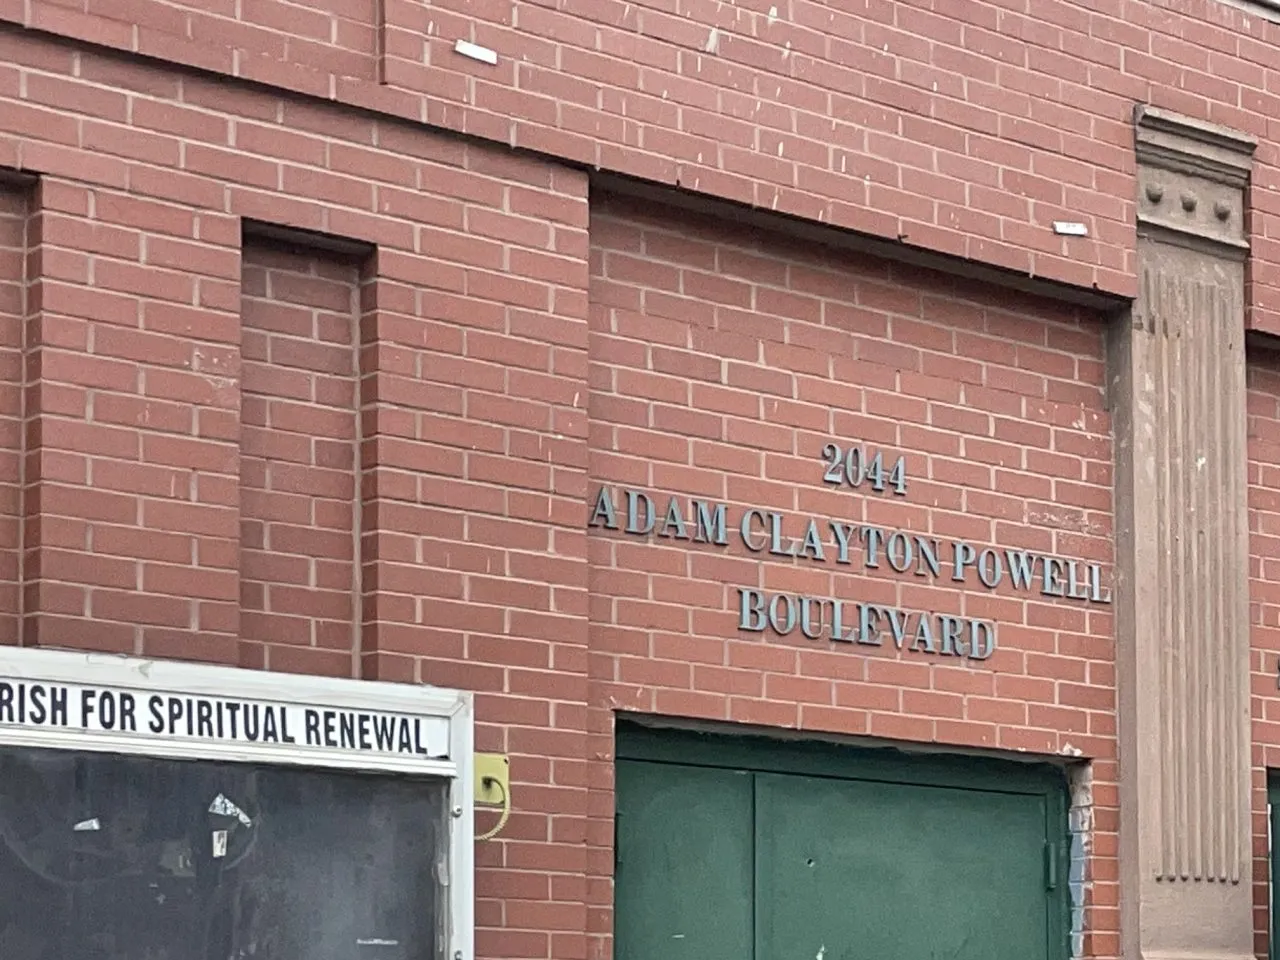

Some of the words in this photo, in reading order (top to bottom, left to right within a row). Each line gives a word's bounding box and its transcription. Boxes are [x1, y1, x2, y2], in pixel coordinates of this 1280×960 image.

[822, 443, 908, 495] 2044
[588, 486, 728, 546] ADAM
[740, 508, 941, 578] CLAYTON
[952, 541, 1112, 604] POWELL
[738, 587, 996, 661] BOULEVARD
[0, 682, 68, 726] RISH
[81, 690, 137, 732] FOR
[149, 695, 295, 744] SPIRITUAL
[305, 709, 428, 755] RENEWAL
